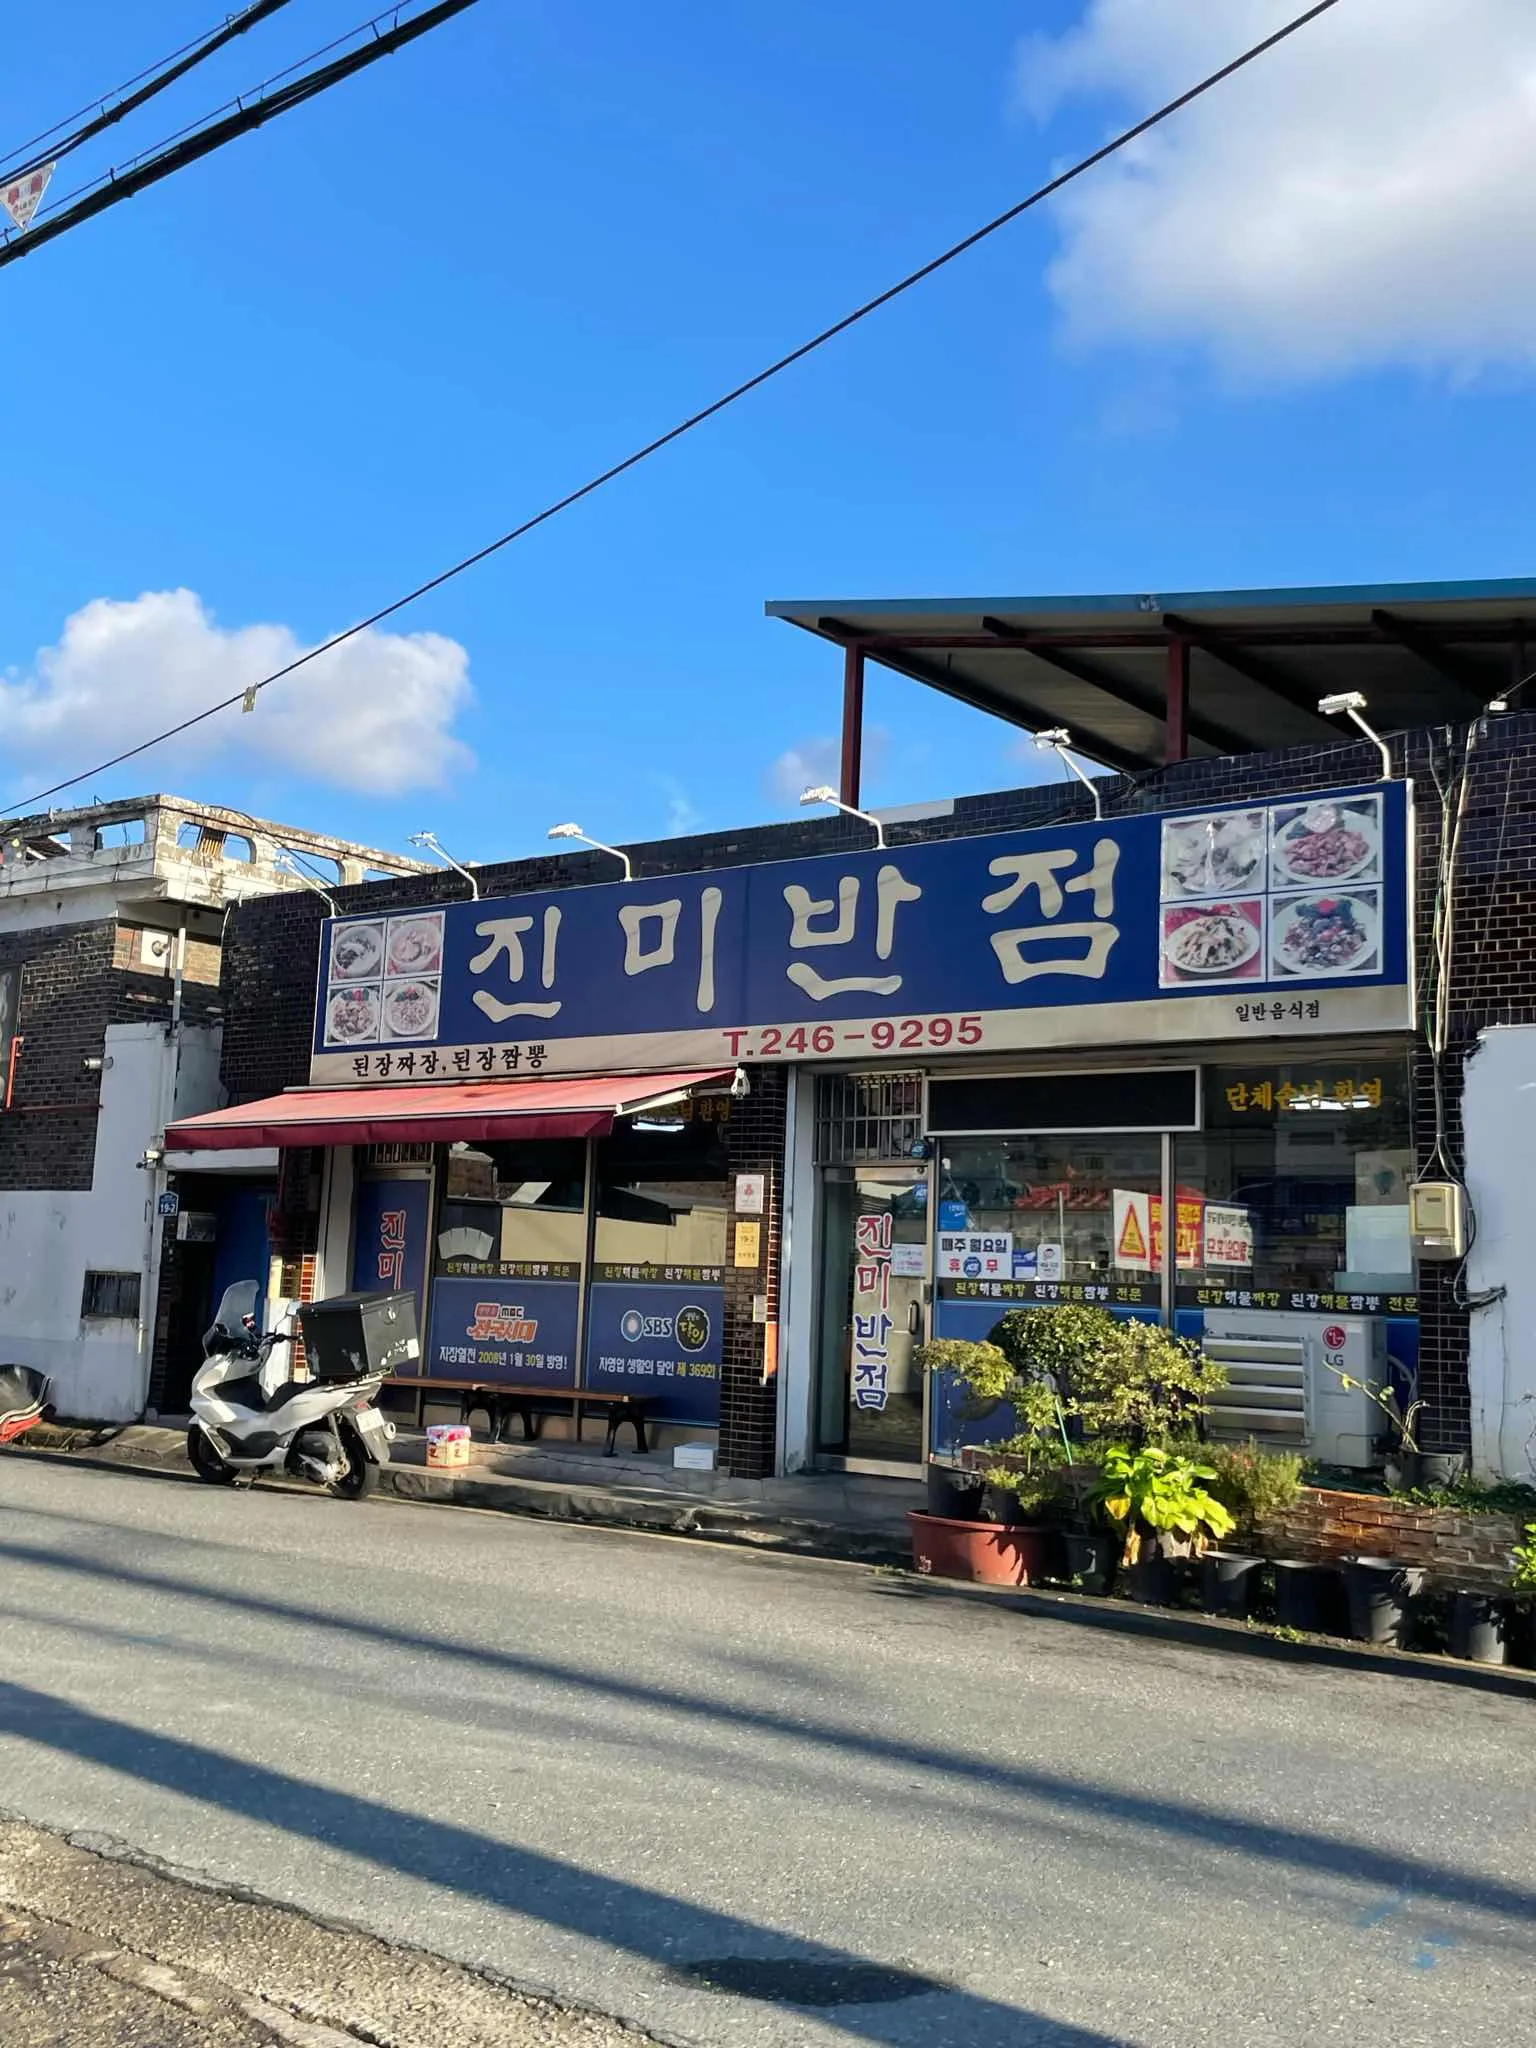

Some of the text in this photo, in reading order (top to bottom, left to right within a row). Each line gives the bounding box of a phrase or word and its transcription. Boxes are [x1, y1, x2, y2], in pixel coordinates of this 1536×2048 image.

[469, 838, 1121, 1023] 진미반점
[1235, 999, 1319, 1022] 일반음식점
[722, 1015, 983, 1057] T.246-9295
[378, 1209, 406, 1290] 진미
[941, 1238, 1007, 1253] 매주 월요일
[955, 1282, 1142, 1302] 된장해물짜장 된장해물짬뽕 전문
[1197, 1289, 1420, 1313] 된장해물짜장 된장해물짬뽕 전문
[854, 1212, 893, 1411] 진미반점
[643, 1317, 672, 1337] SBS
[439, 1346, 477, 1363] 자장열전
[510, 1352, 523, 1367] 1월
[525, 1353, 544, 1369] 30일
[546, 1354, 568, 1370] 방영!
[599, 1357, 625, 1373] 자영업
[627, 1358, 654, 1375] 생활의
[656, 1360, 674, 1376] 달인
[676, 1361, 686, 1377] 제
[688, 1363, 716, 1379] 369회
[1326, 1354, 1344, 1366] LG
